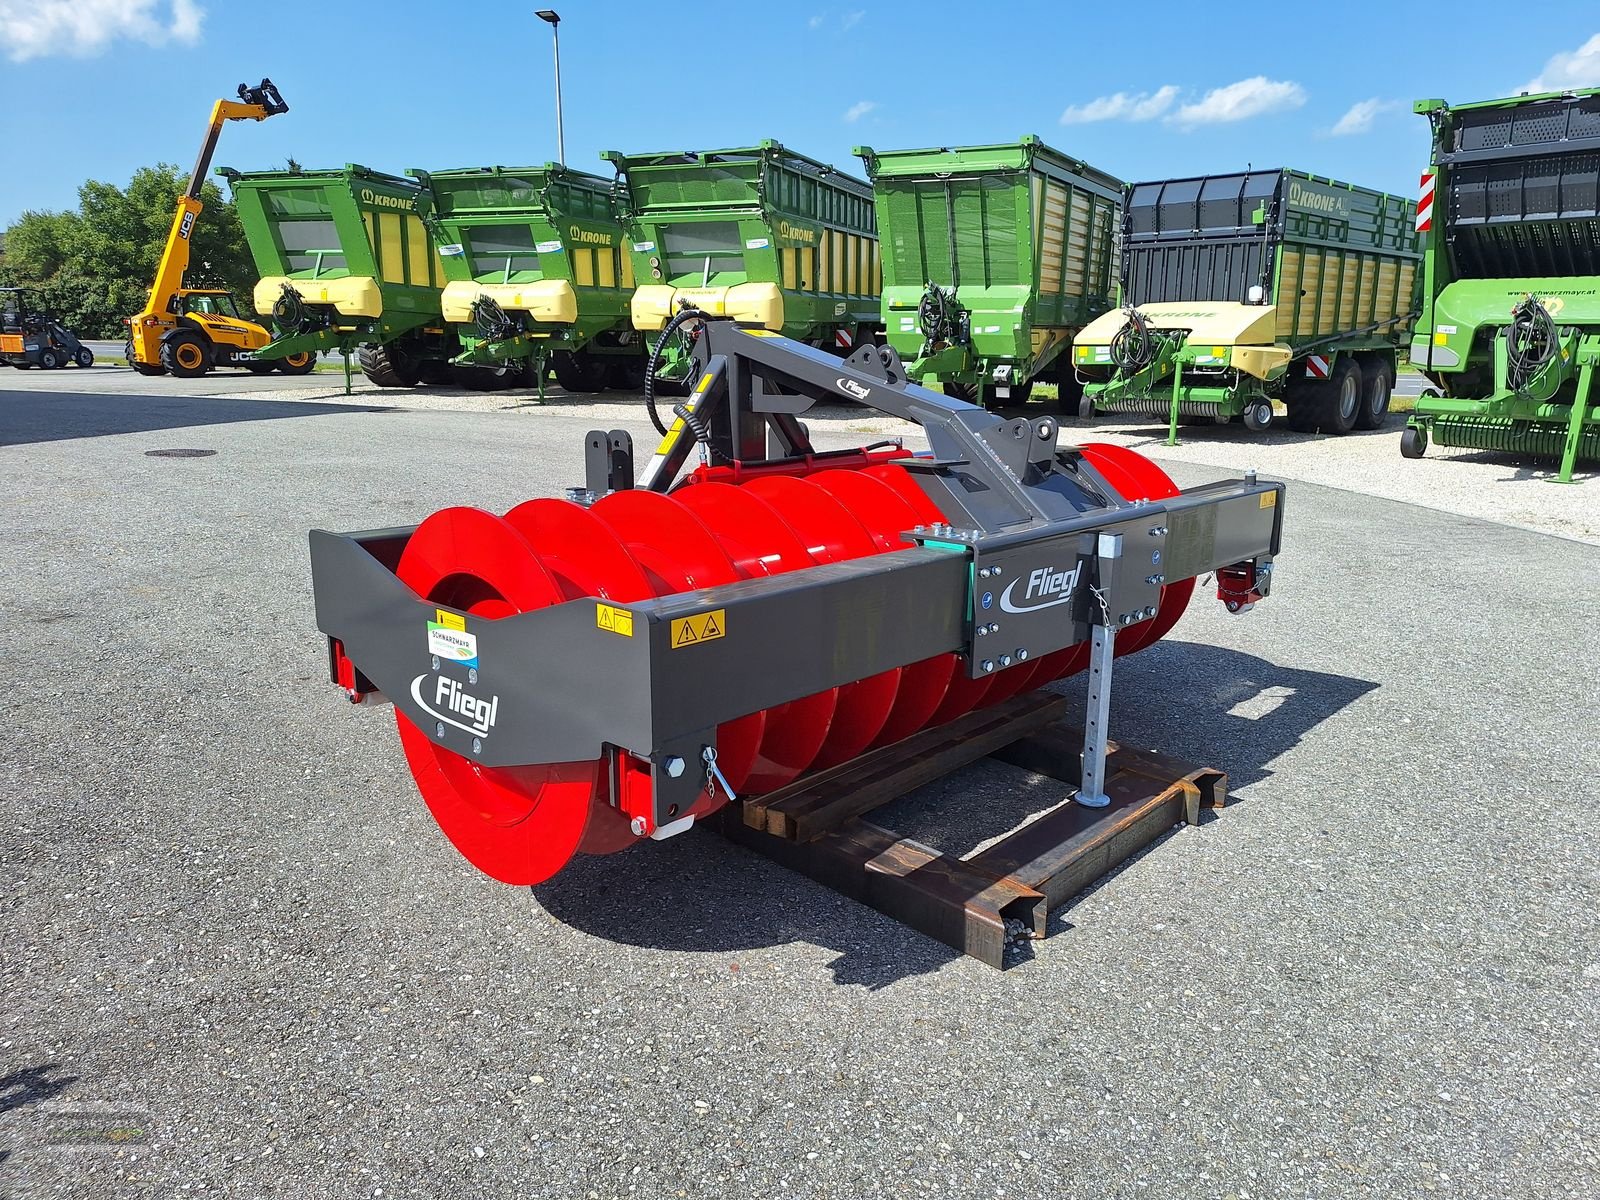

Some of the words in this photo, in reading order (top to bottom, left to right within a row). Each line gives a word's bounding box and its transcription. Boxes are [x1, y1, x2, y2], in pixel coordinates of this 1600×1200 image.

[374, 194, 413, 210] KRONE
[1300, 190, 1336, 212] KRONE
[180, 211, 194, 239] JCB
[789, 226, 814, 243] KRONE
[581, 232, 612, 245] KRONE
[846, 379, 871, 399] Fliegl
[1025, 560, 1083, 599] Fliegl
[435, 675, 499, 732] Fliegl
